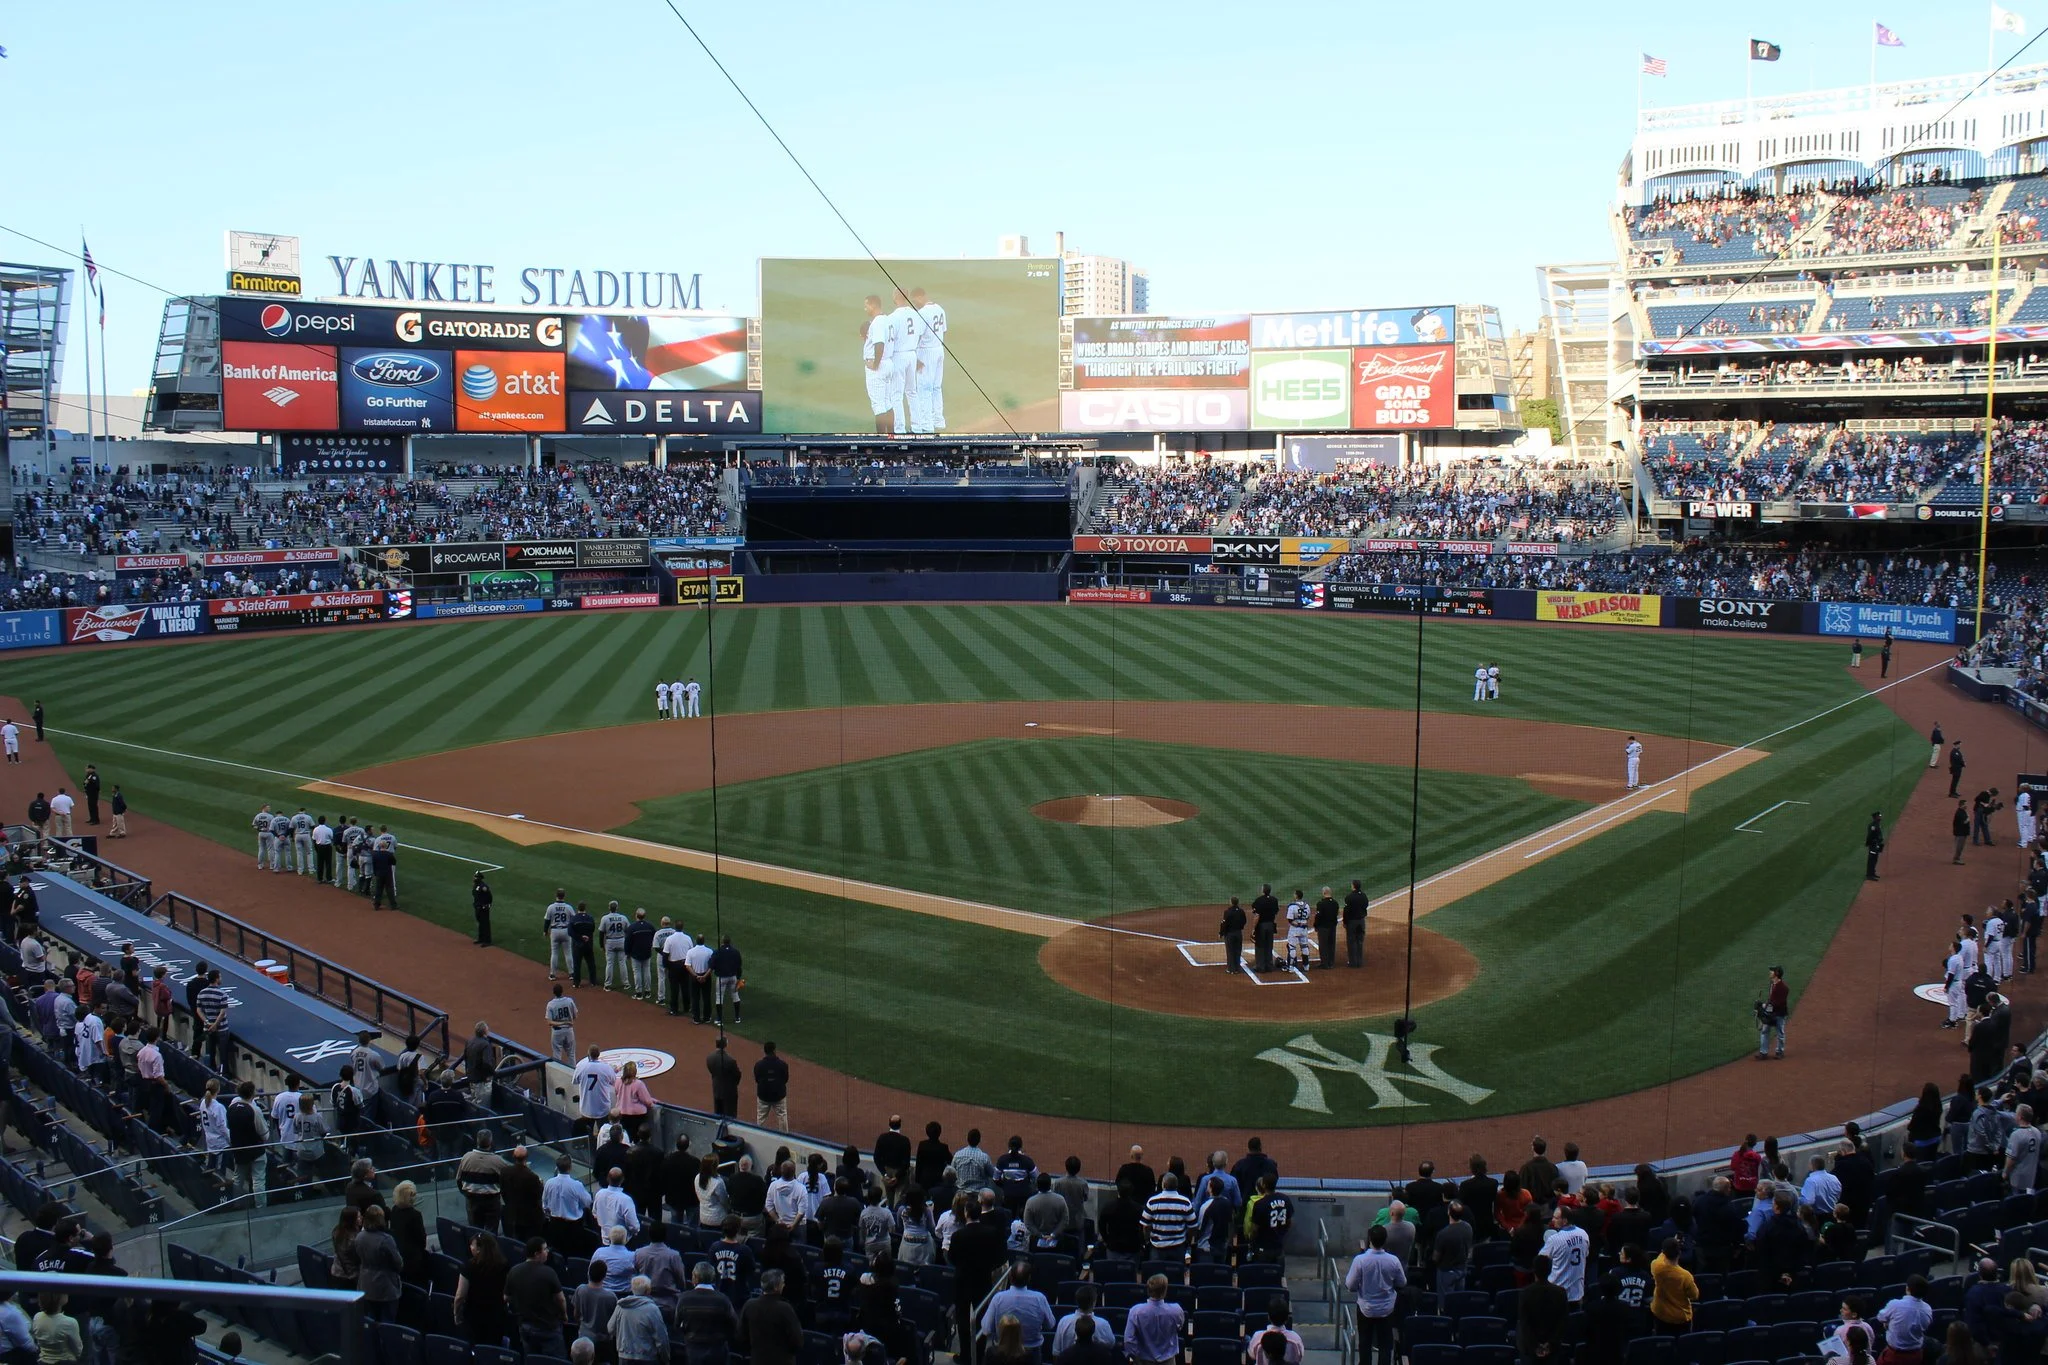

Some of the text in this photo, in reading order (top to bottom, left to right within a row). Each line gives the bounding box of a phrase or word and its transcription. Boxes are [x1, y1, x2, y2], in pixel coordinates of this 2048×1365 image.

[232, 273, 300, 294] Armitron
[326, 255, 703, 310] YANKEE STADIUM
[294, 314, 355, 335] pepsi
[396, 312, 563, 346] G GATORADE G
[907, 317, 915, 335] 2
[1110, 319, 1216, 330] AS WRITTEN BY FRANCIS SCOTT KEY
[1262, 311, 1400, 347] MetLife
[1077, 343, 1106, 357] WHOSE
[1106, 342, 1135, 357] BROAD
[1135, 341, 1171, 356] STRIPES
[1171, 341, 1188, 356] AND
[1189, 341, 1220, 355] BRIGHT
[224, 363, 337, 382] Bank of America
[369, 356, 422, 382] Ford
[1084, 360, 1240, 377] THROUGH THE PERILOUS FIGHT,
[1359, 360, 1444, 378] Budweiser
[504, 371, 560, 395] at&t
[1262, 379, 1341, 401] HESS
[1375, 385, 1431, 400] GRAB
[367, 397, 428, 408] Go Further
[1079, 393, 1232, 426] CASIO
[1384, 400, 1421, 409] SOME
[626, 400, 750, 423] DELTA
[1376, 409, 1430, 424] BUDS
[363, 418, 417, 428] tristateford.com
[522, 546, 574, 557] YOKOHAMA
[1124, 539, 1189, 552] TOYOTA
[1213, 543, 1280, 559] DKNY
[1300, 546, 1326, 559] SAP
[1370, 541, 1413, 550] MODELL'S
[1443, 543, 1488, 552] MODELL'S
[1508, 544, 1556, 554] MODELL'S
[137, 556, 180, 567] State Farm
[224, 553, 264, 563] State Farm
[295, 551, 333, 561] State Farm
[445, 552, 501, 564] ROCAWEAR
[583, 557, 643, 565] STEINERSPORTS.COM
[665, 560, 695, 569] Peanut
[1194, 563, 1220, 574] FedEx
[683, 584, 736, 596] STANLEY
[237, 599, 290, 612] State Farm
[326, 594, 374, 606] State Farm
[592, 596, 657, 606] DUNKIN' DONUTS
[1547, 596, 1562, 604] WHO
[436, 602, 525, 616] freecreditscore.com
[1699, 599, 1775, 616] SONY
[73, 616, 146, 632] Budweiser
[214, 617, 240, 625] MARINERS
[1702, 618, 1768, 629] make.believe
[1858, 608, 1942, 626] Merrill Lynch
[159, 617, 196, 633] A HERO
[216, 623, 238, 631] YANKEES
[1891, 626, 1949, 640] Management
[554, 913, 567, 923] 28
[609, 922, 623, 933] 48
[558, 1007, 569, 1018] 88
[587, 1073, 599, 1091] 7
[286, 1104, 295, 1119] 2
[202, 1111, 210, 1127] 2
[2029, 1138, 2036, 1153] 2
[1270, 1208, 1287, 1228] 24
[1566, 1235, 1583, 1247] RUTH
[715, 1250, 740, 1261] RIVERA
[1570, 1247, 1581, 1266] 3
[716, 1260, 737, 1281] 42
[823, 1268, 846, 1280] JETER
[827, 1279, 841, 1299] 2
[1620, 1276, 1646, 1288] RIVERA
[1618, 1287, 1644, 1307] 42
